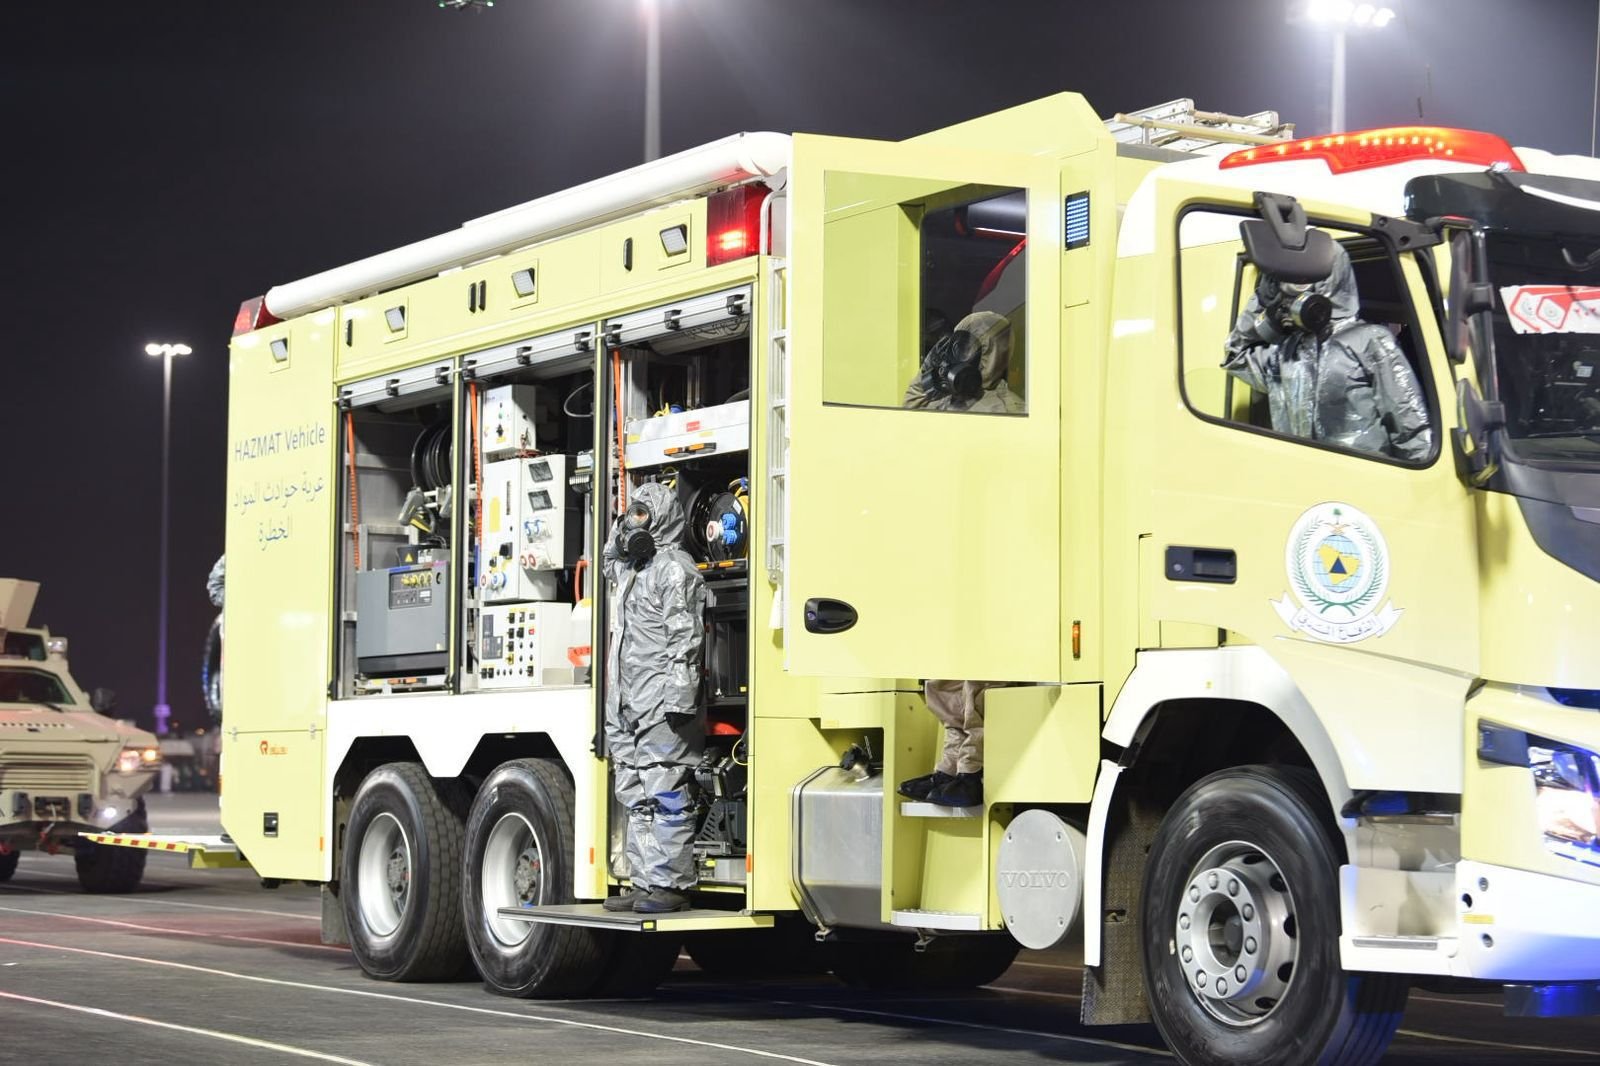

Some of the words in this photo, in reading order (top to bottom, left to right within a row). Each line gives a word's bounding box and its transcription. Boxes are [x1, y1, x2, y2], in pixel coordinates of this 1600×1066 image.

[234, 431, 283, 462] HAZMAT
[285, 421, 326, 451] Vehicle
[233, 481, 260, 516] المواد
[263, 478, 298, 509] حوادث
[302, 471, 324, 503] عربة
[258, 515, 293, 552] الخطرة
[1000, 870, 1070, 888] VOLVO
